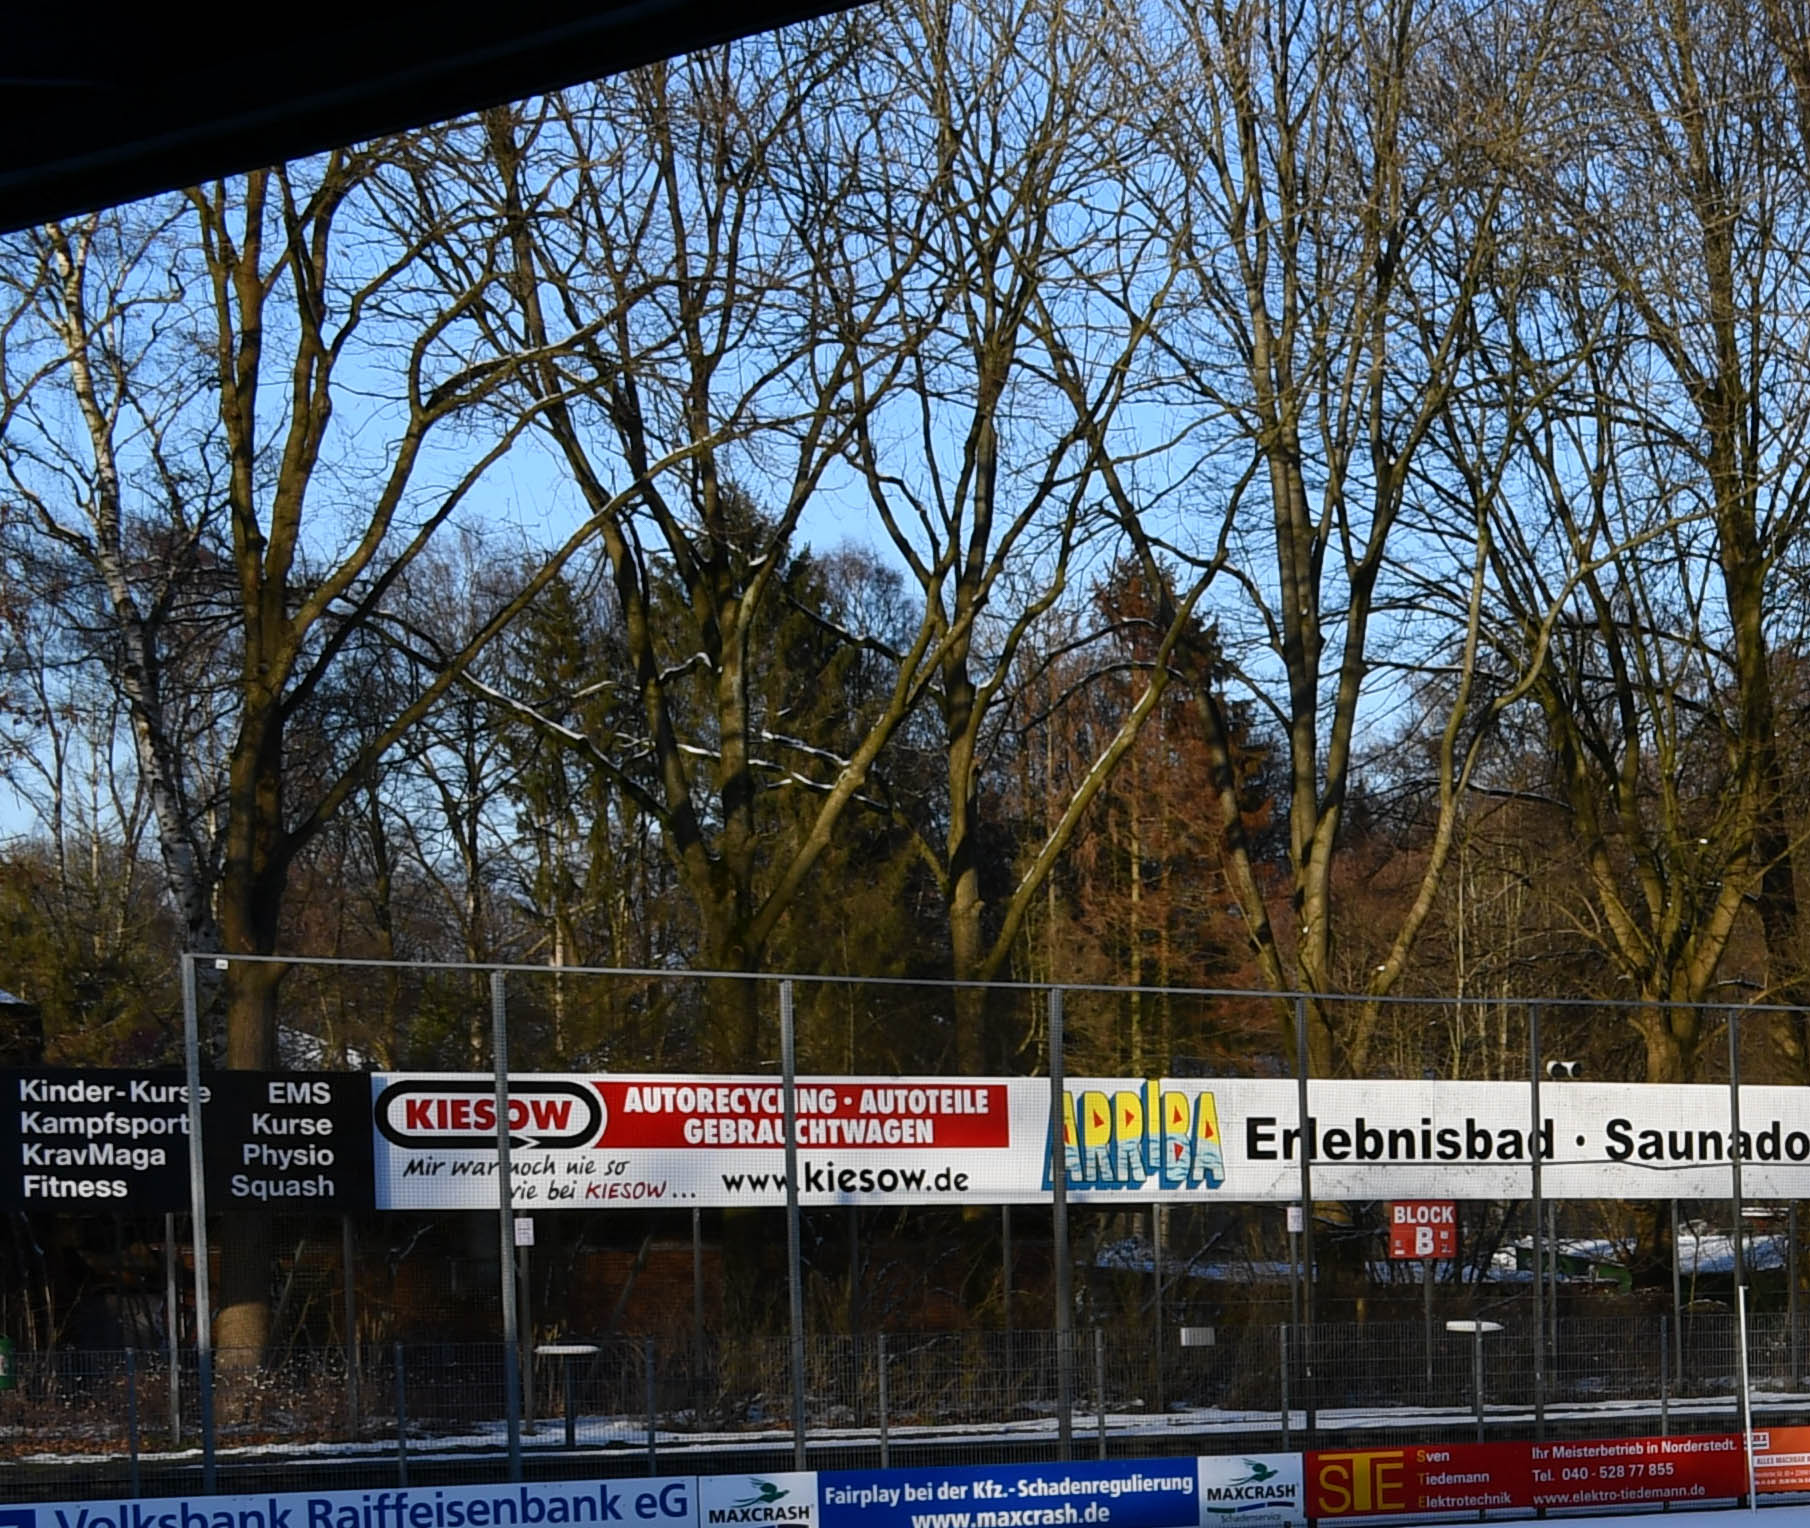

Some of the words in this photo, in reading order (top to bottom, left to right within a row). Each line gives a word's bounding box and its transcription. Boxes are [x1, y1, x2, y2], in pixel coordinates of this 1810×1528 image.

[20, 1080, 210, 1102] Kinder-Kurse
[268, 1082, 331, 1104] EMS
[859, 1089, 988, 1115] AUTOTEILE
[21, 1112, 191, 1138] Kampfsport
[252, 1113, 333, 1135] Kurse
[406, 1099, 571, 1129] KIESOW
[684, 1118, 934, 1145] GEBRAUCHTWAGEN
[1042, 1080, 1225, 1190] ARRIBA
[1247, 1117, 1554, 1160] Erlebnisbad
[22, 1144, 165, 1170] KravMaga
[243, 1144, 334, 1170] Physio
[403, 1157, 444, 1176] Mir
[453, 1160, 500, 1176] war
[509, 1155, 555, 1175] noch
[567, 1156, 596, 1175] nie
[604, 1160, 630, 1175] so
[24, 1175, 127, 1197] Fitness
[232, 1175, 334, 1201] Squash
[722, 1161, 969, 1193] www.kiesow.de
[548, 1179, 575, 1200] bei
[586, 1181, 666, 1200] KIESOW
[1394, 1206, 1454, 1224] BLOCK
[1416, 1227, 1434, 1255] B
[1416, 1450, 1450, 1463] Sven
[1532, 1447, 1548, 1459] Ihr
[1553, 1442, 1644, 1459] Meisterbetrieb
[1646, 1442, 1658, 1453] in
[1661, 1438, 1737, 1453] Norderstedt.
[1318, 1451, 1405, 1513] STE
[1417, 1472, 1489, 1486] Tiedemann
[1532, 1469, 1555, 1482] Tel.
[1562, 1467, 1588, 1481] 040
[1600, 1466, 1625, 1479] 528
[1629, 1464, 1644, 1477] 77
[1648, 1463, 1674, 1476] 855
[635, 1483, 687, 1518] eG
[825, 1485, 899, 1507] Fairplay
[905, 1483, 933, 1501] bei
[938, 1482, 966, 1500] der
[1207, 1482, 1297, 1501] MAXCRASH
[1418, 1492, 1511, 1508] Elektrotechnik
[1533, 1484, 1706, 1504] www.elektro-tiedemann.de
[709, 1506, 810, 1524] MAXCRASH
